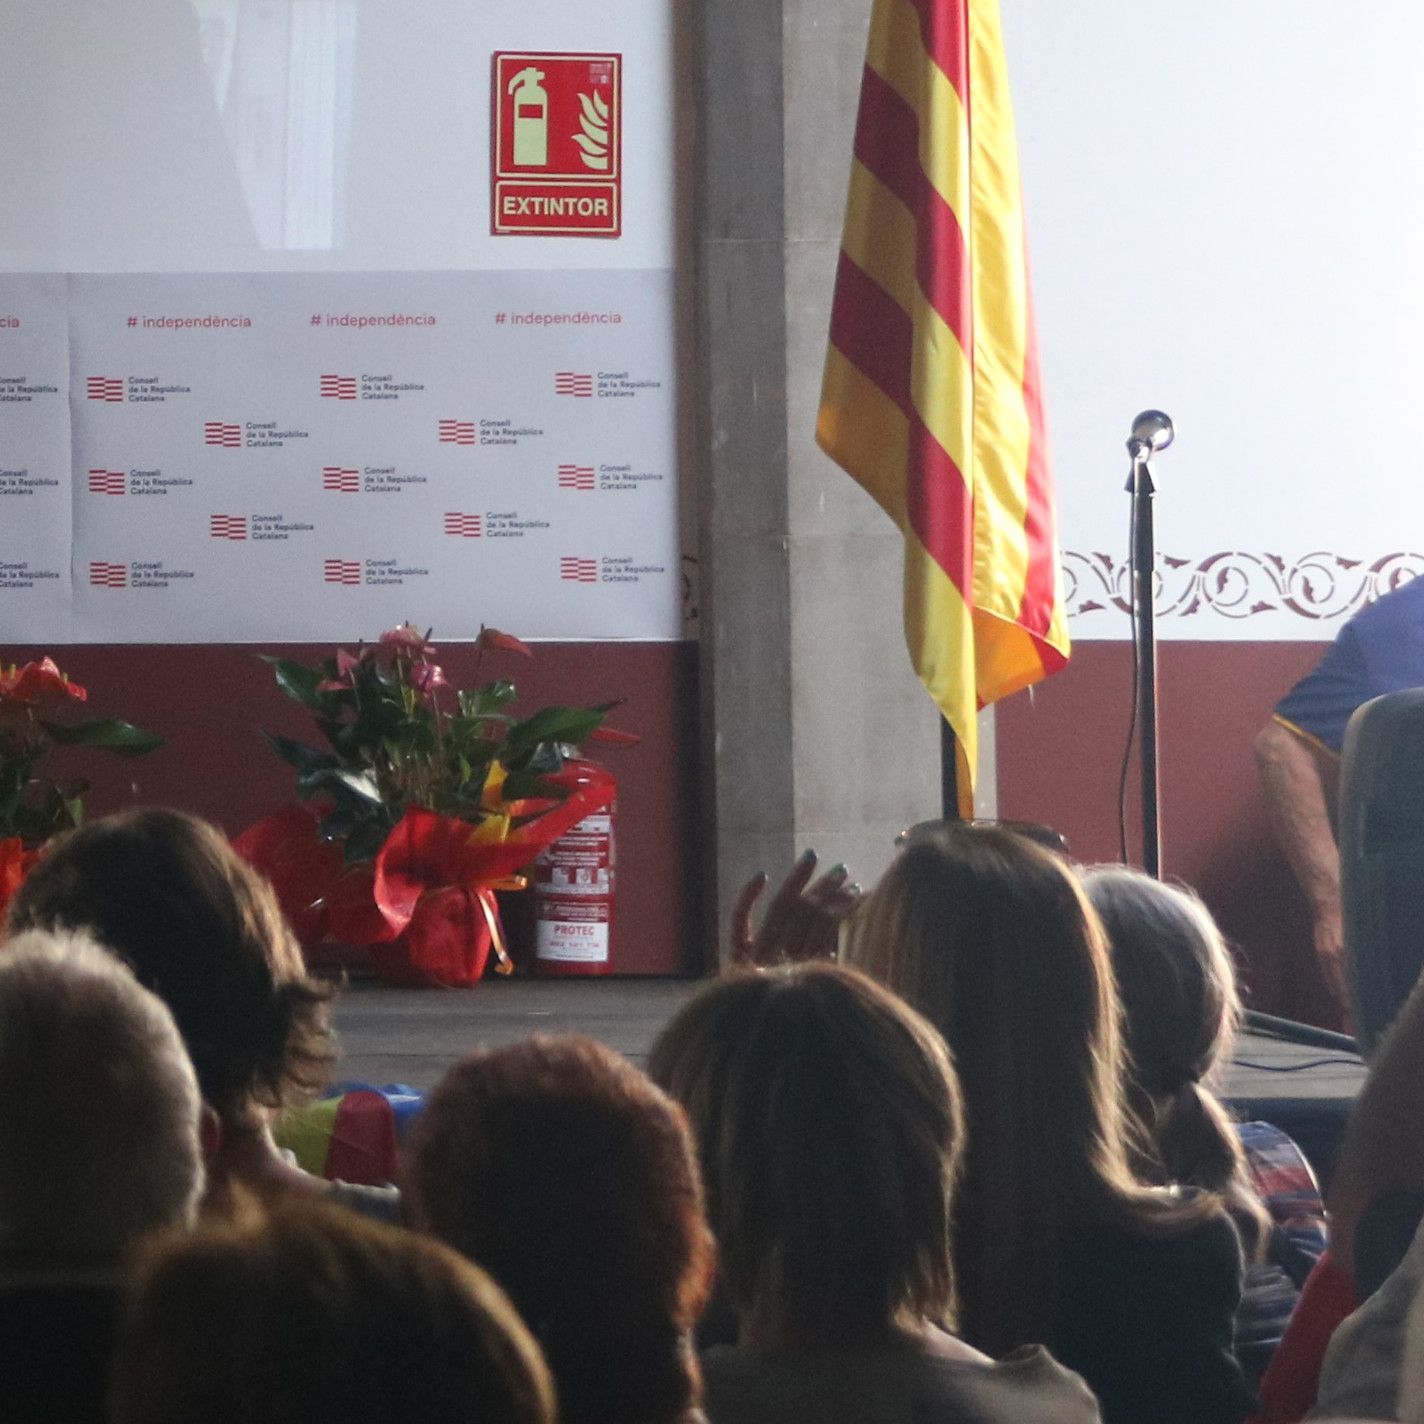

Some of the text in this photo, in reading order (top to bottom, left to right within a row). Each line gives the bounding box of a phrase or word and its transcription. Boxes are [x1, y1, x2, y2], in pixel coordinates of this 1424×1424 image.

[503, 196, 608, 216] EXTINTOR
[127, 315, 252, 330] # independència
[311, 313, 436, 328] # independència
[495, 311, 621, 327] # independència
[361, 374, 392, 382] Consell
[128, 394, 165, 402] Catalana
[362, 392, 398, 400] Catalana
[246, 422, 277, 430] Consell
[480, 419, 511, 427] Consell
[480, 437, 517, 445] Catalana
[130, 469, 161, 477] Consell
[130, 487, 167, 495] Catalana
[486, 530, 523, 538] Catalana
